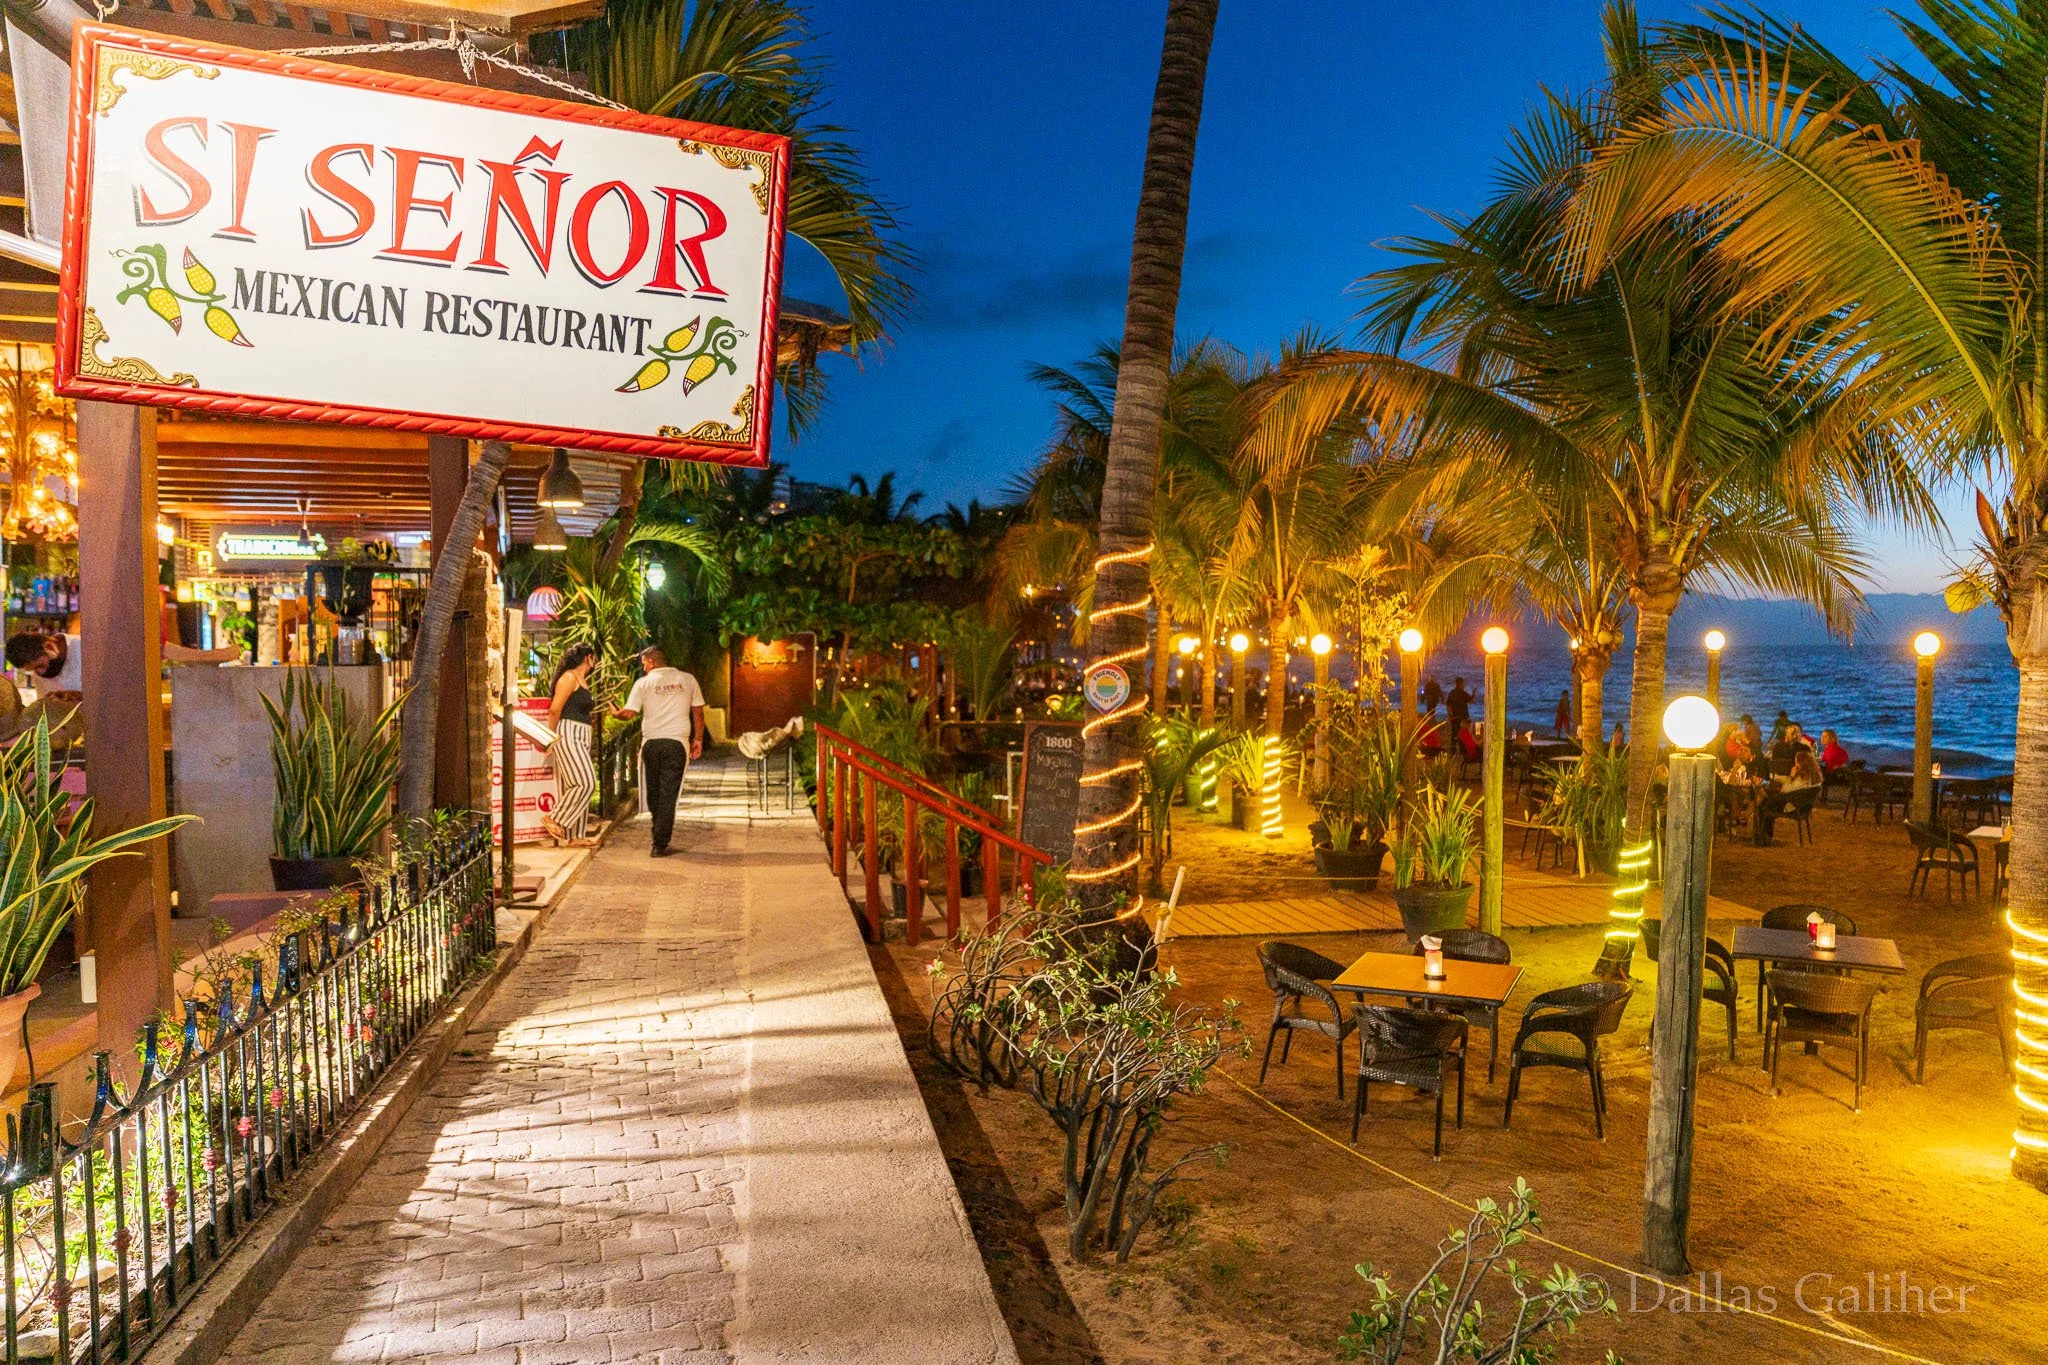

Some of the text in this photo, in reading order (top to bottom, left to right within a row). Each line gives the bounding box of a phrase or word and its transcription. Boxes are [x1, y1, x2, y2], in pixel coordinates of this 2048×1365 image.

[133, 115, 730, 302] SI SEÑOR
[232, 266, 653, 357] MEXICAN RESTAURANT
[1093, 670, 1122, 681] FRIENDLY
[1046, 736, 1072, 748] 1800
